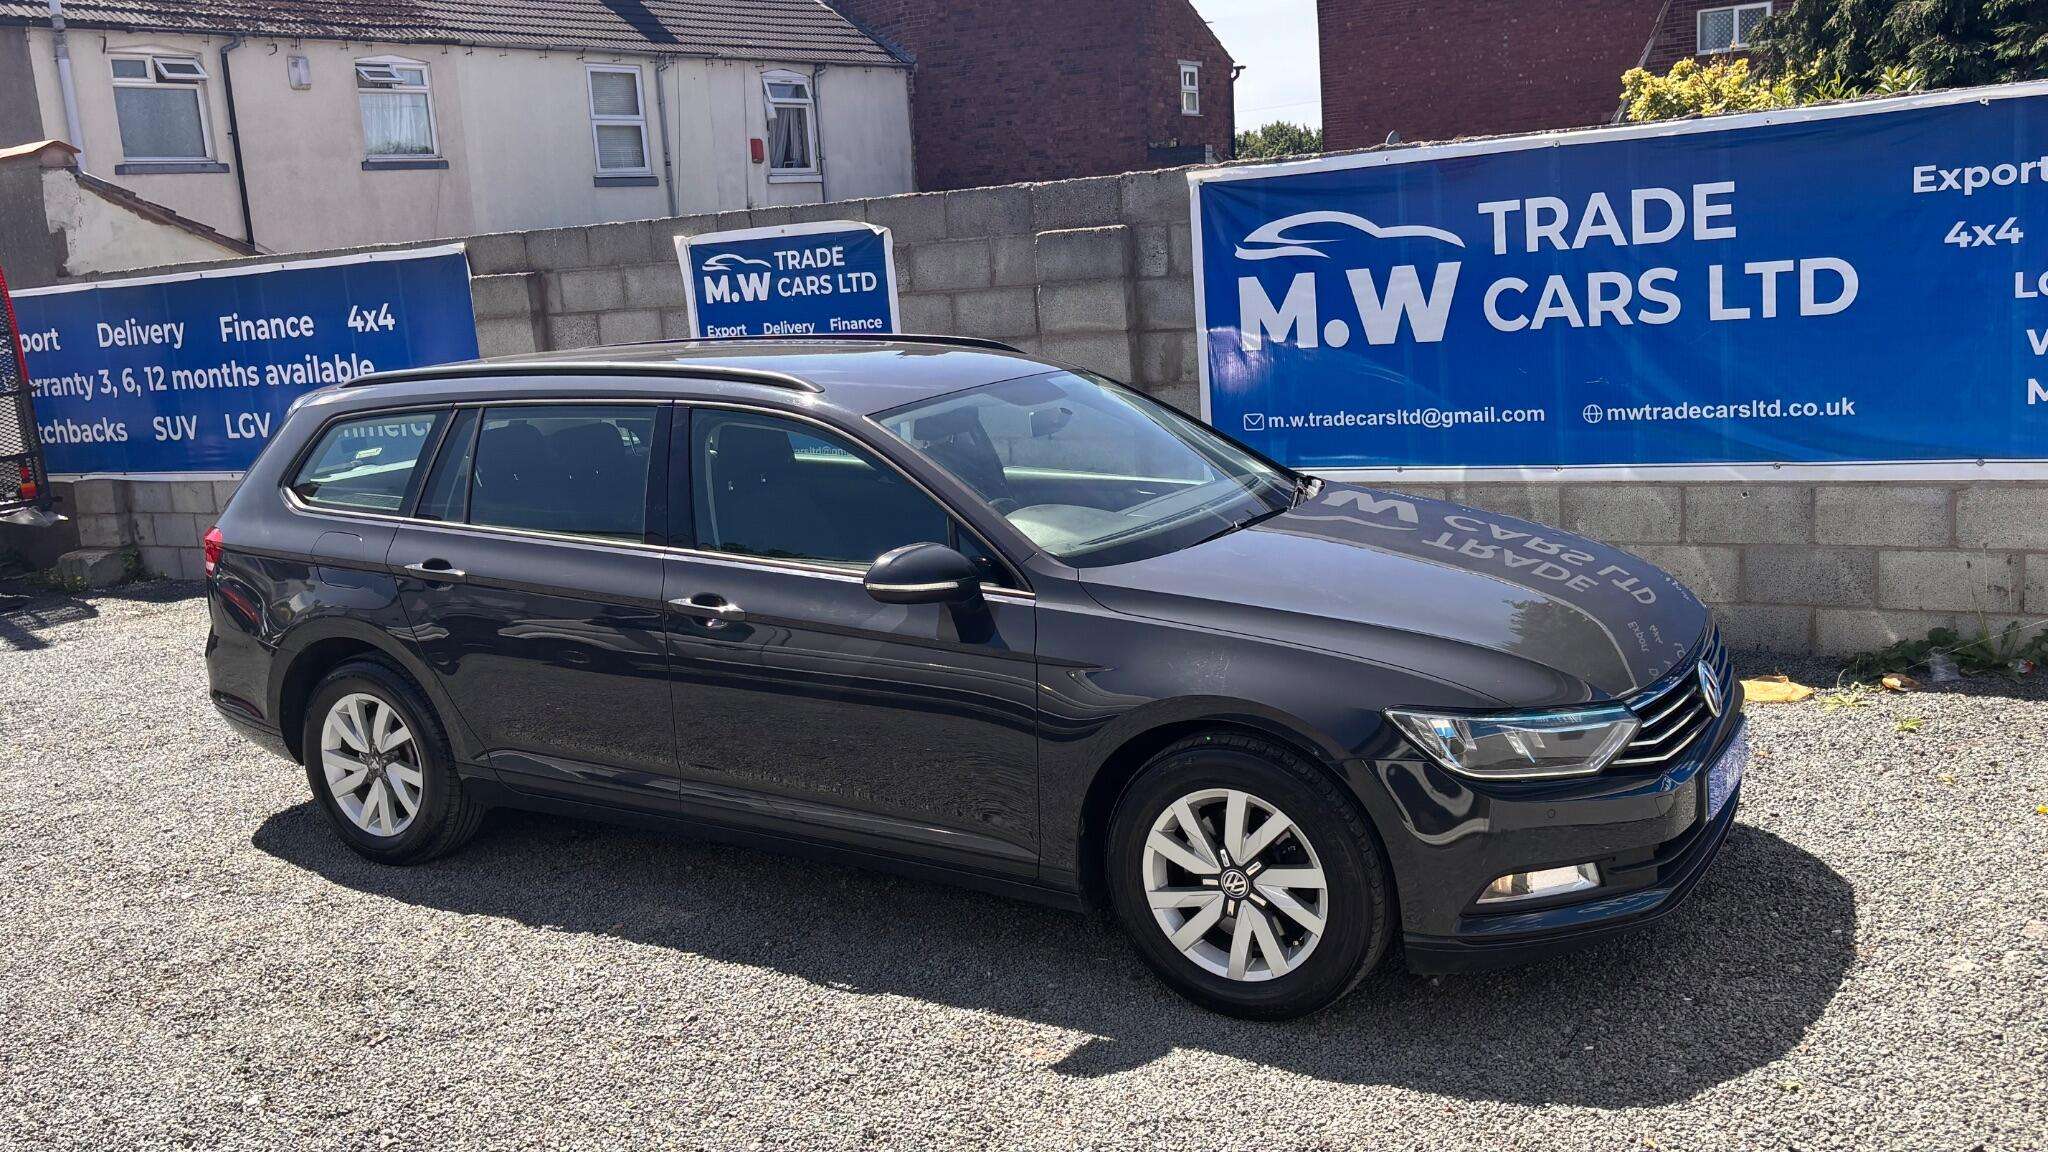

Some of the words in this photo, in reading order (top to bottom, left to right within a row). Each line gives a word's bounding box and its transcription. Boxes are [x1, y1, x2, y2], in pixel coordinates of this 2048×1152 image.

[1913, 156, 2048, 196] Export
[1478, 181, 1737, 256] TRADE
[1944, 216, 2024, 249] 4x4
[774, 246, 845, 271] TRADE
[704, 271, 771, 304] M.W
[777, 275, 833, 298] CARS
[837, 271, 877, 293] LTD
[1483, 268, 1682, 332] CARS
[1709, 257, 1859, 321] LTD
[1238, 261, 1462, 352] M.W
[19, 328, 61, 357] port
[96, 317, 185, 350] Delivery
[219, 312, 315, 344] Finance
[347, 303, 396, 334] 4x4
[707, 324, 747, 337] Export
[763, 320, 816, 336] Delivery
[829, 317, 883, 332] Finance
[98, 369, 118, 398] 3,
[121, 367, 142, 397] 6,
[143, 366, 168, 392] 12
[171, 359, 260, 390] months
[265, 353, 375, 386] available
[1268, 406, 1545, 429] m.w.tradecarsltd@gmail.com
[1606, 396, 1855, 420] mwtradecarsltd.co.uk
[37, 416, 128, 445] tchbacks
[152, 415, 197, 441] SUV
[225, 412, 271, 439] LGV
